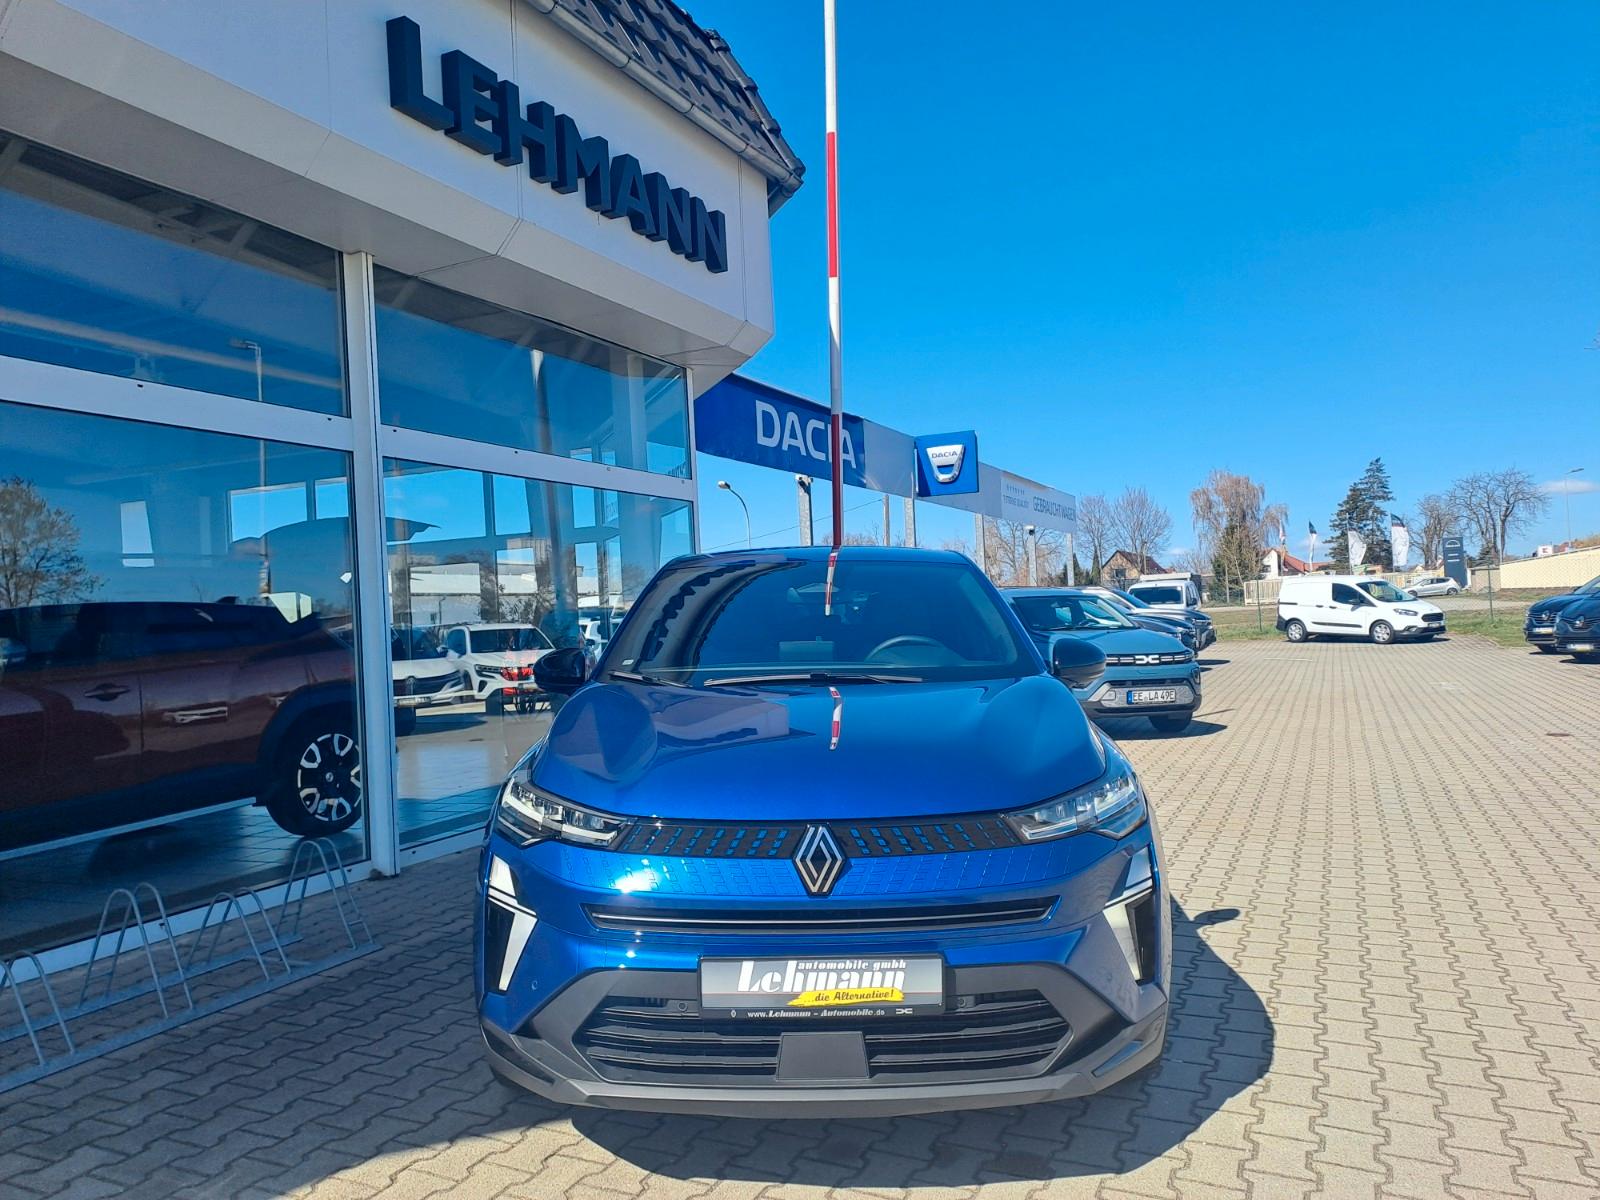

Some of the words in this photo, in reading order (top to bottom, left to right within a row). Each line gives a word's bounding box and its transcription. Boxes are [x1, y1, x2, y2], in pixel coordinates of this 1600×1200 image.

[386, 16, 728, 273] LEHMANN
[755, 400, 857, 469] DACIA
[931, 450, 958, 459] DACIA
[1133, 692, 1143, 701] EE
[798, 959, 869, 970] automobile
[873, 959, 907, 971] gmbh
[737, 960, 905, 992] Lehmann
[834, 989, 894, 1001] Alternative!
